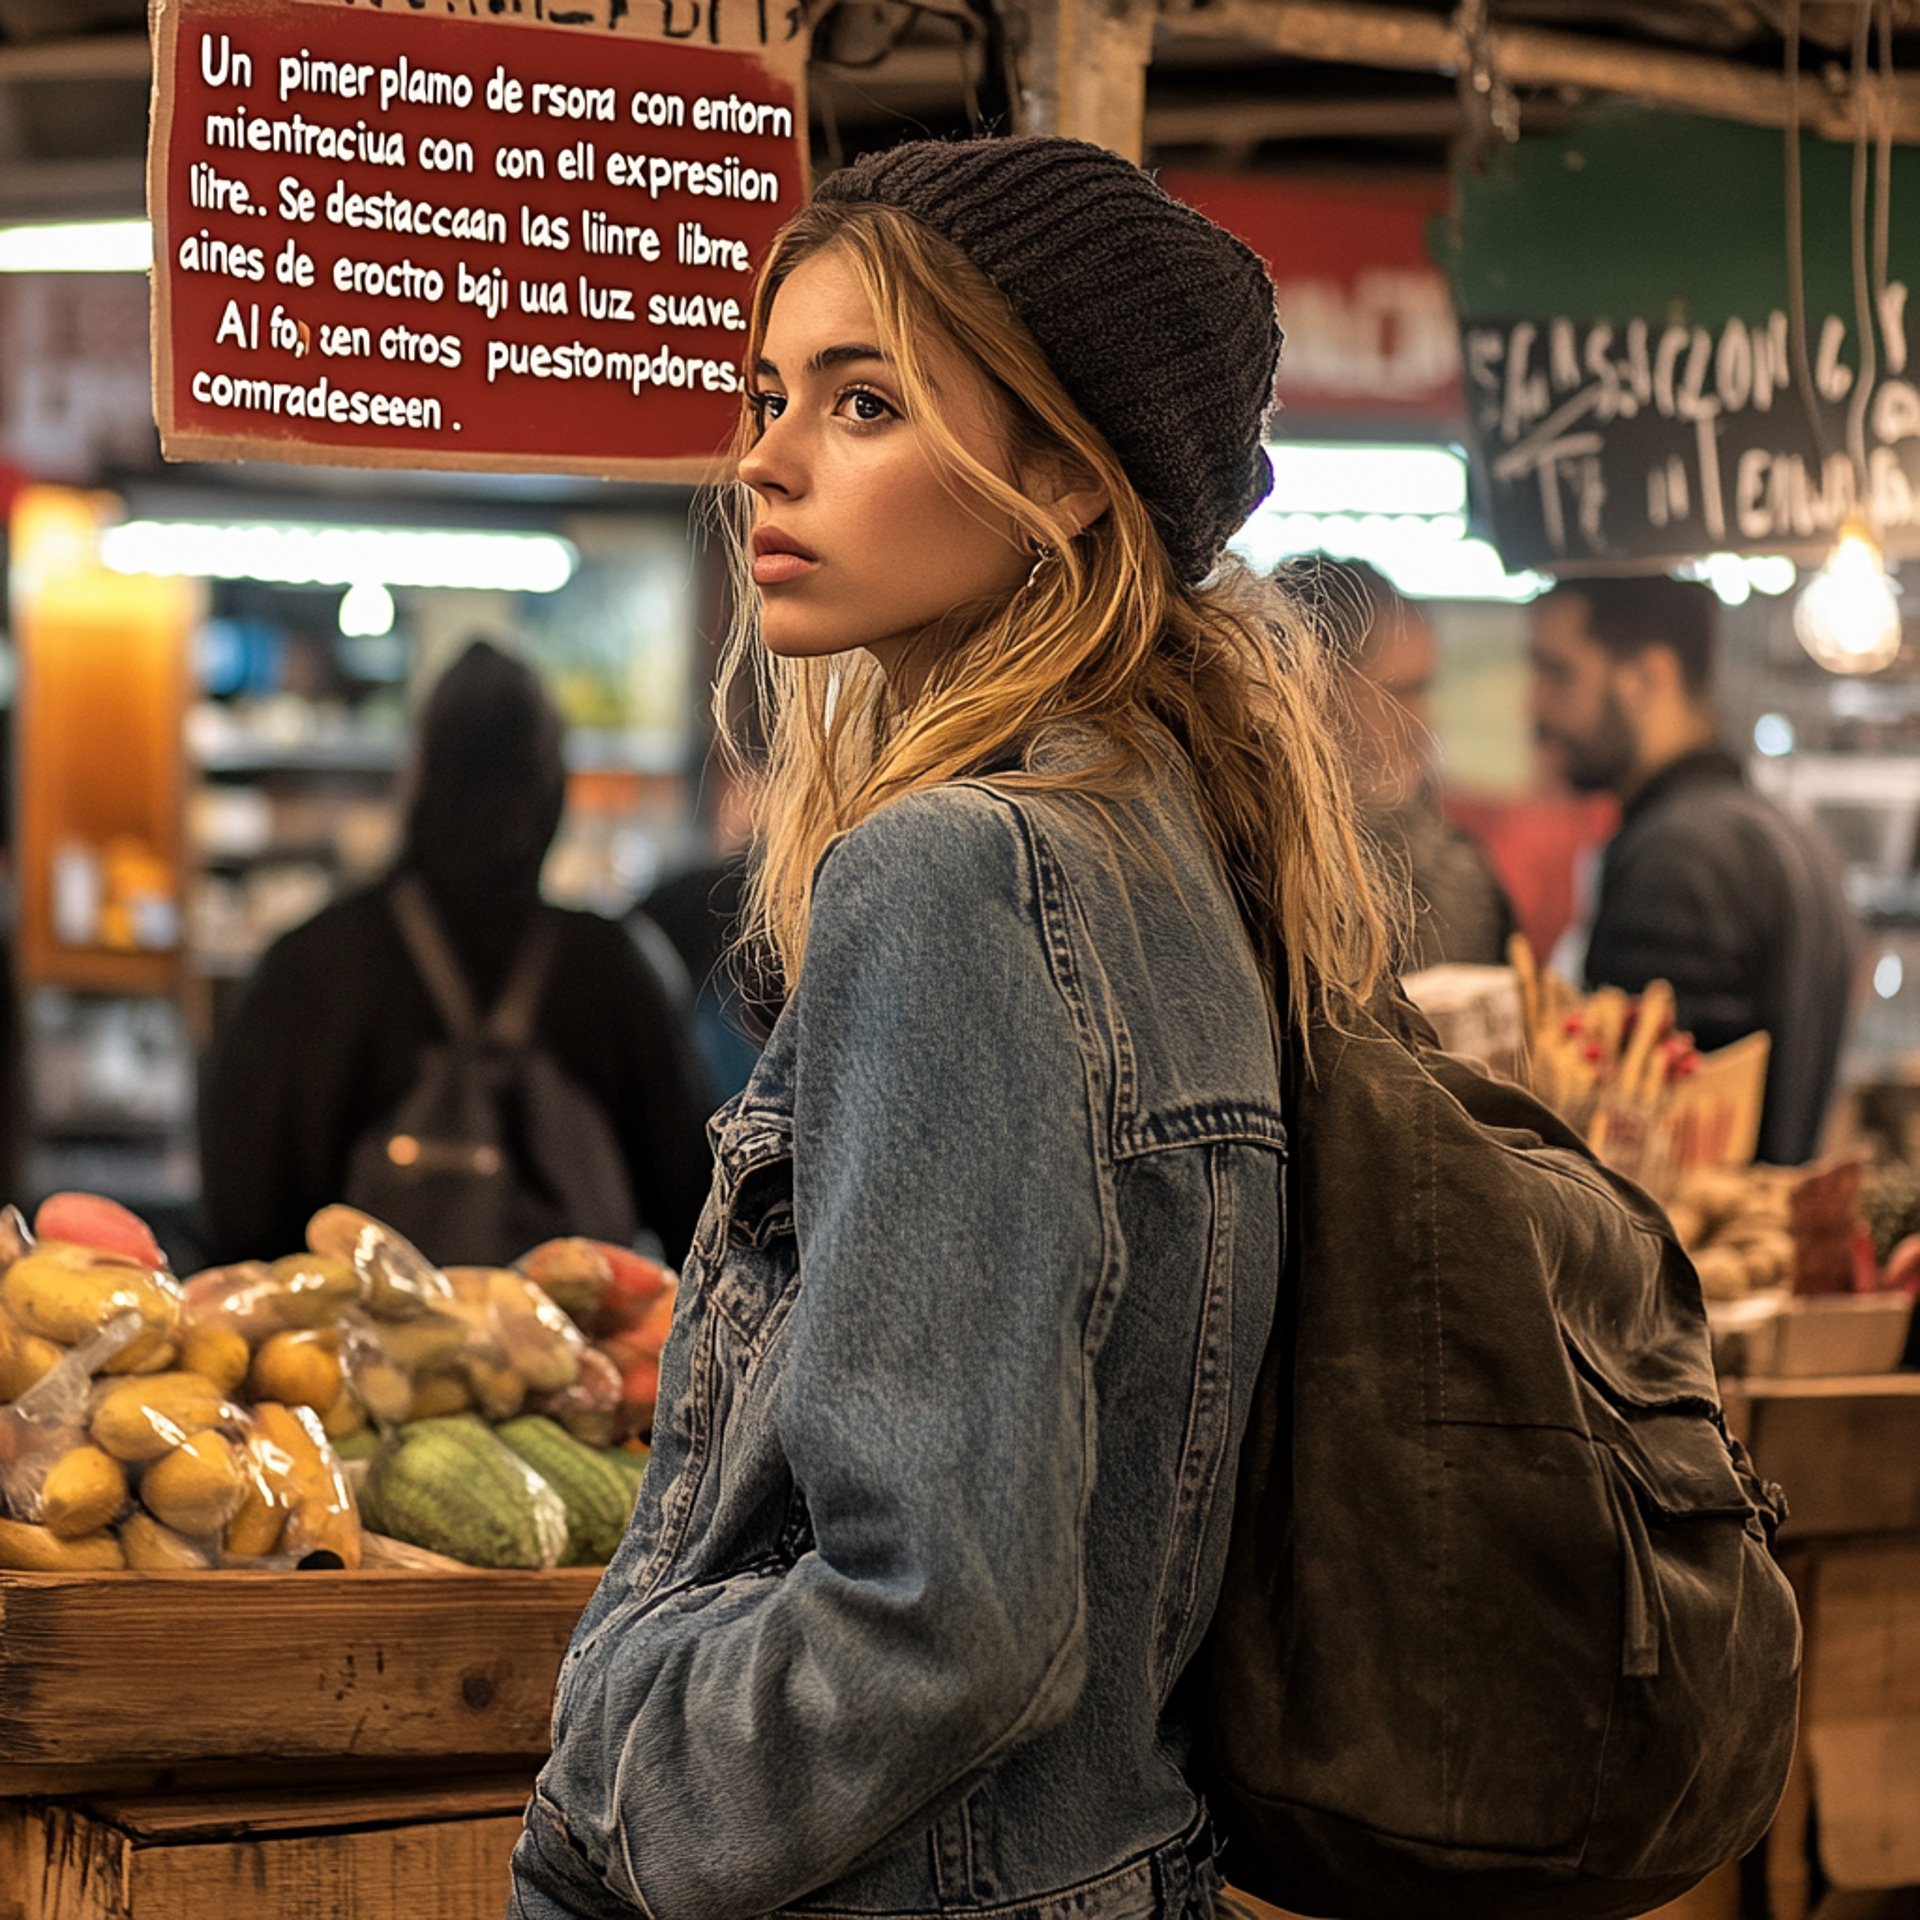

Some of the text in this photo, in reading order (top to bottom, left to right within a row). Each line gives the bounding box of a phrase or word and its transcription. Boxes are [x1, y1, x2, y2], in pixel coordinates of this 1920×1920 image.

[201, 34, 252, 87] Un
[280, 48, 375, 102] pimer
[486, 65, 524, 114] de
[631, 91, 685, 127] con
[692, 94, 792, 138] entorn
[419, 137, 474, 173] con
[495, 147, 545, 179] con
[557, 141, 595, 181] ell
[606, 152, 778, 203] expresiion
[278, 176, 316, 222] Se
[521, 205, 570, 250] las
[179, 229, 265, 281] aines
[275, 238, 315, 287] de
[648, 294, 747, 330] suave.
[216, 299, 259, 350] Al
[379, 325, 462, 368] otros
